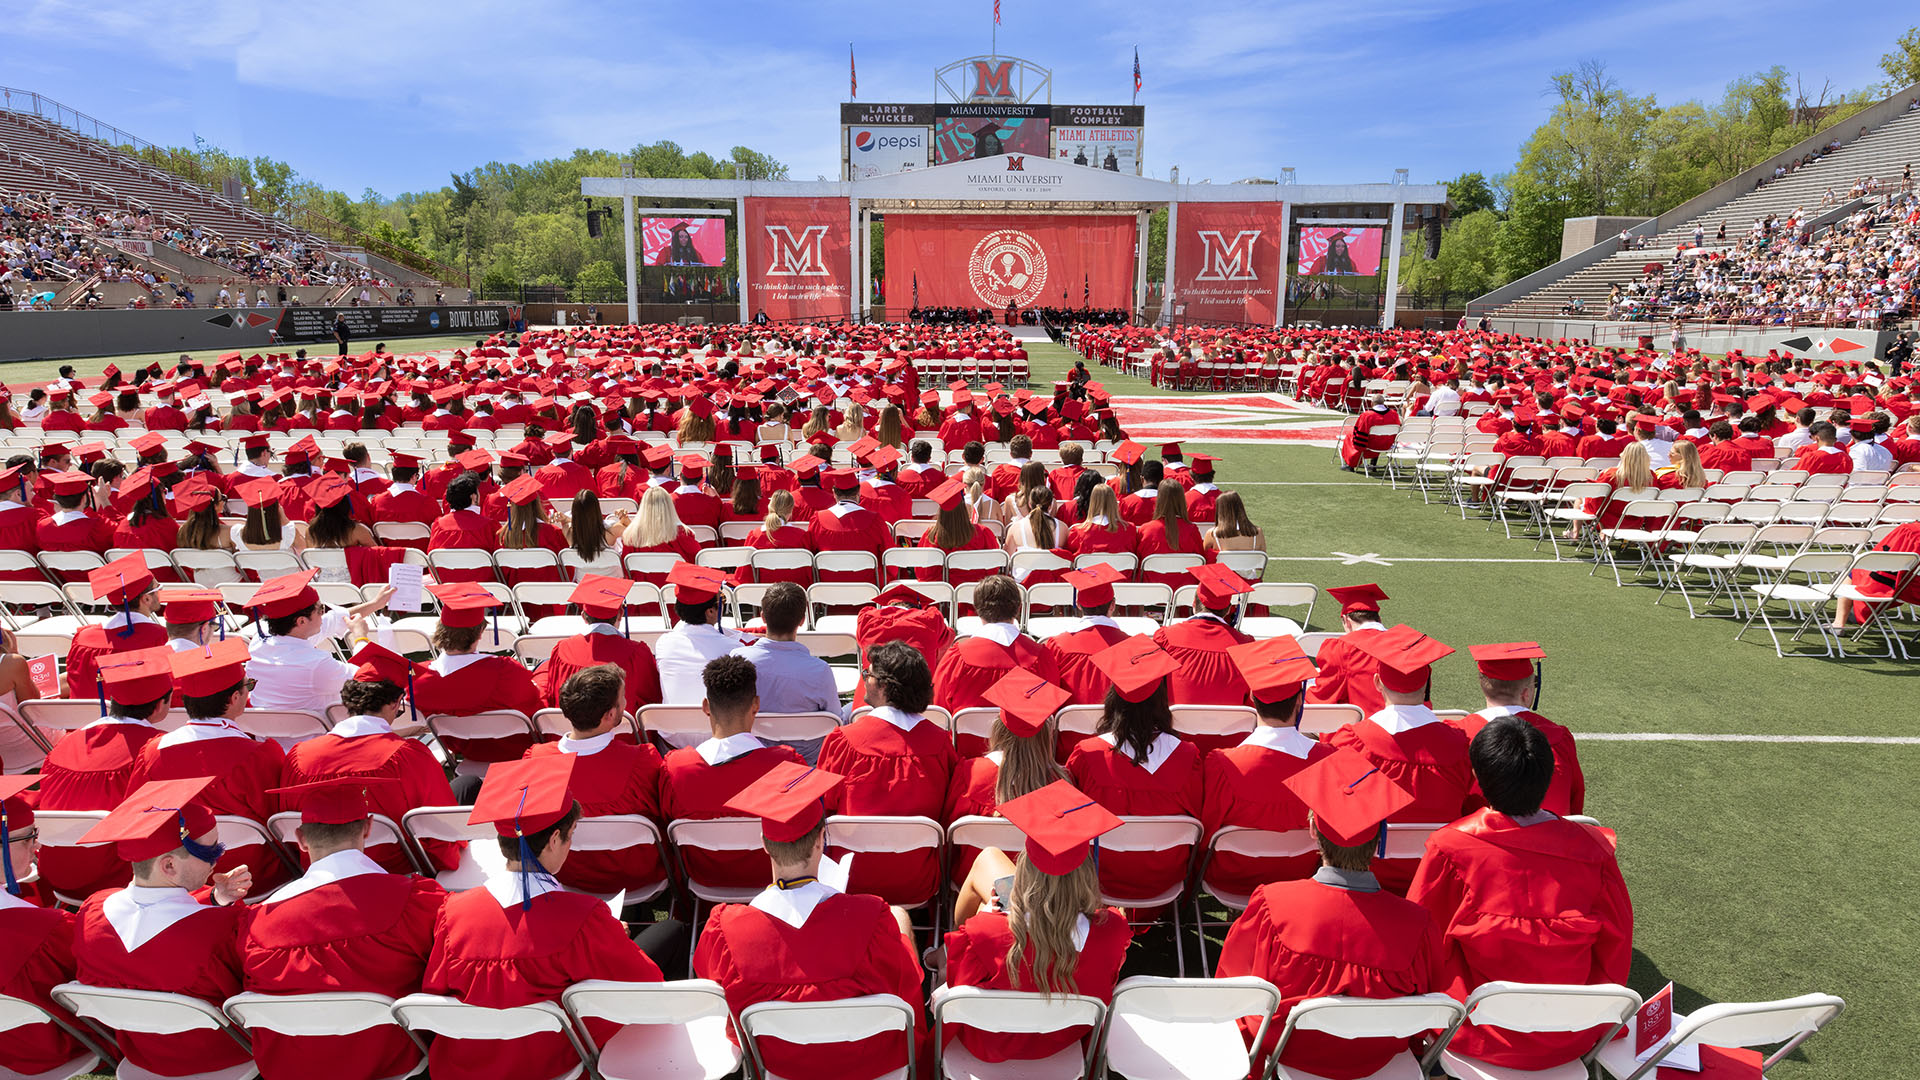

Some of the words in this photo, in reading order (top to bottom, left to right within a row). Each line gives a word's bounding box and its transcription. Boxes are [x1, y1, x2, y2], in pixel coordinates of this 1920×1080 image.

[972, 61, 1016, 97] M
[983, 107, 1035, 115] UNIVERSITY
[878, 135, 920, 150] pepsi
[1059, 129, 1086, 140] MIAMI
[1088, 130, 1135, 141] ATHLETICS
[1007, 156, 1024, 171] M
[967, 175, 1001, 183] MIAMI
[1006, 176, 1063, 184] UNIVERSITY
[765, 226, 830, 276] M
[1195, 231, 1262, 280] M
[449, 311, 472, 328] BOWL
[474, 310, 499, 327] GAMES
